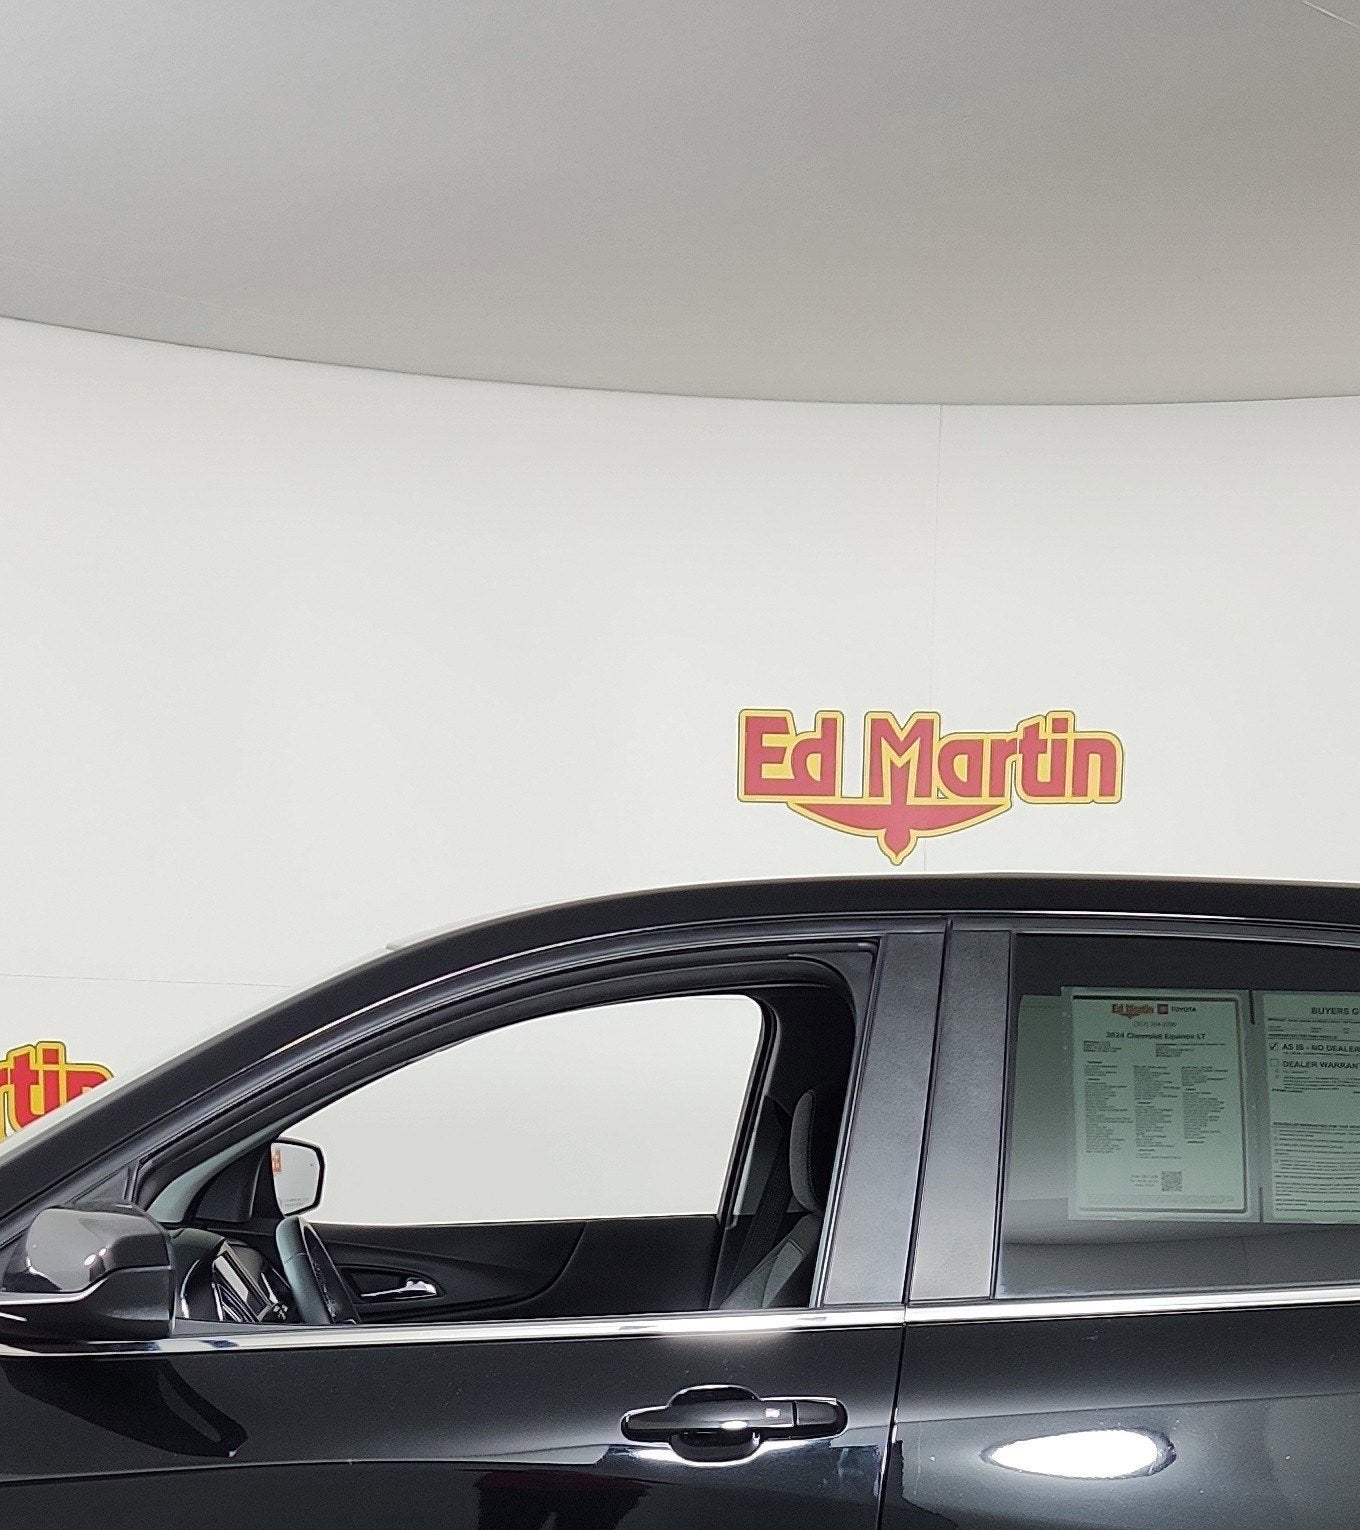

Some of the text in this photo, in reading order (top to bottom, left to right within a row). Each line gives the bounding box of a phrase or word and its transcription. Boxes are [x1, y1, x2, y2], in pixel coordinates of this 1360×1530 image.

[739, 709, 1124, 804] Ed Martin
[1311, 1007, 1350, 1016] BUYERS
[1282, 1043, 1294, 1051] AS
[1295, 1043, 1304, 1051] IS
[1326, 1044, 1360, 1053] DEALER
[1282, 1060, 1318, 1069] DEALER
